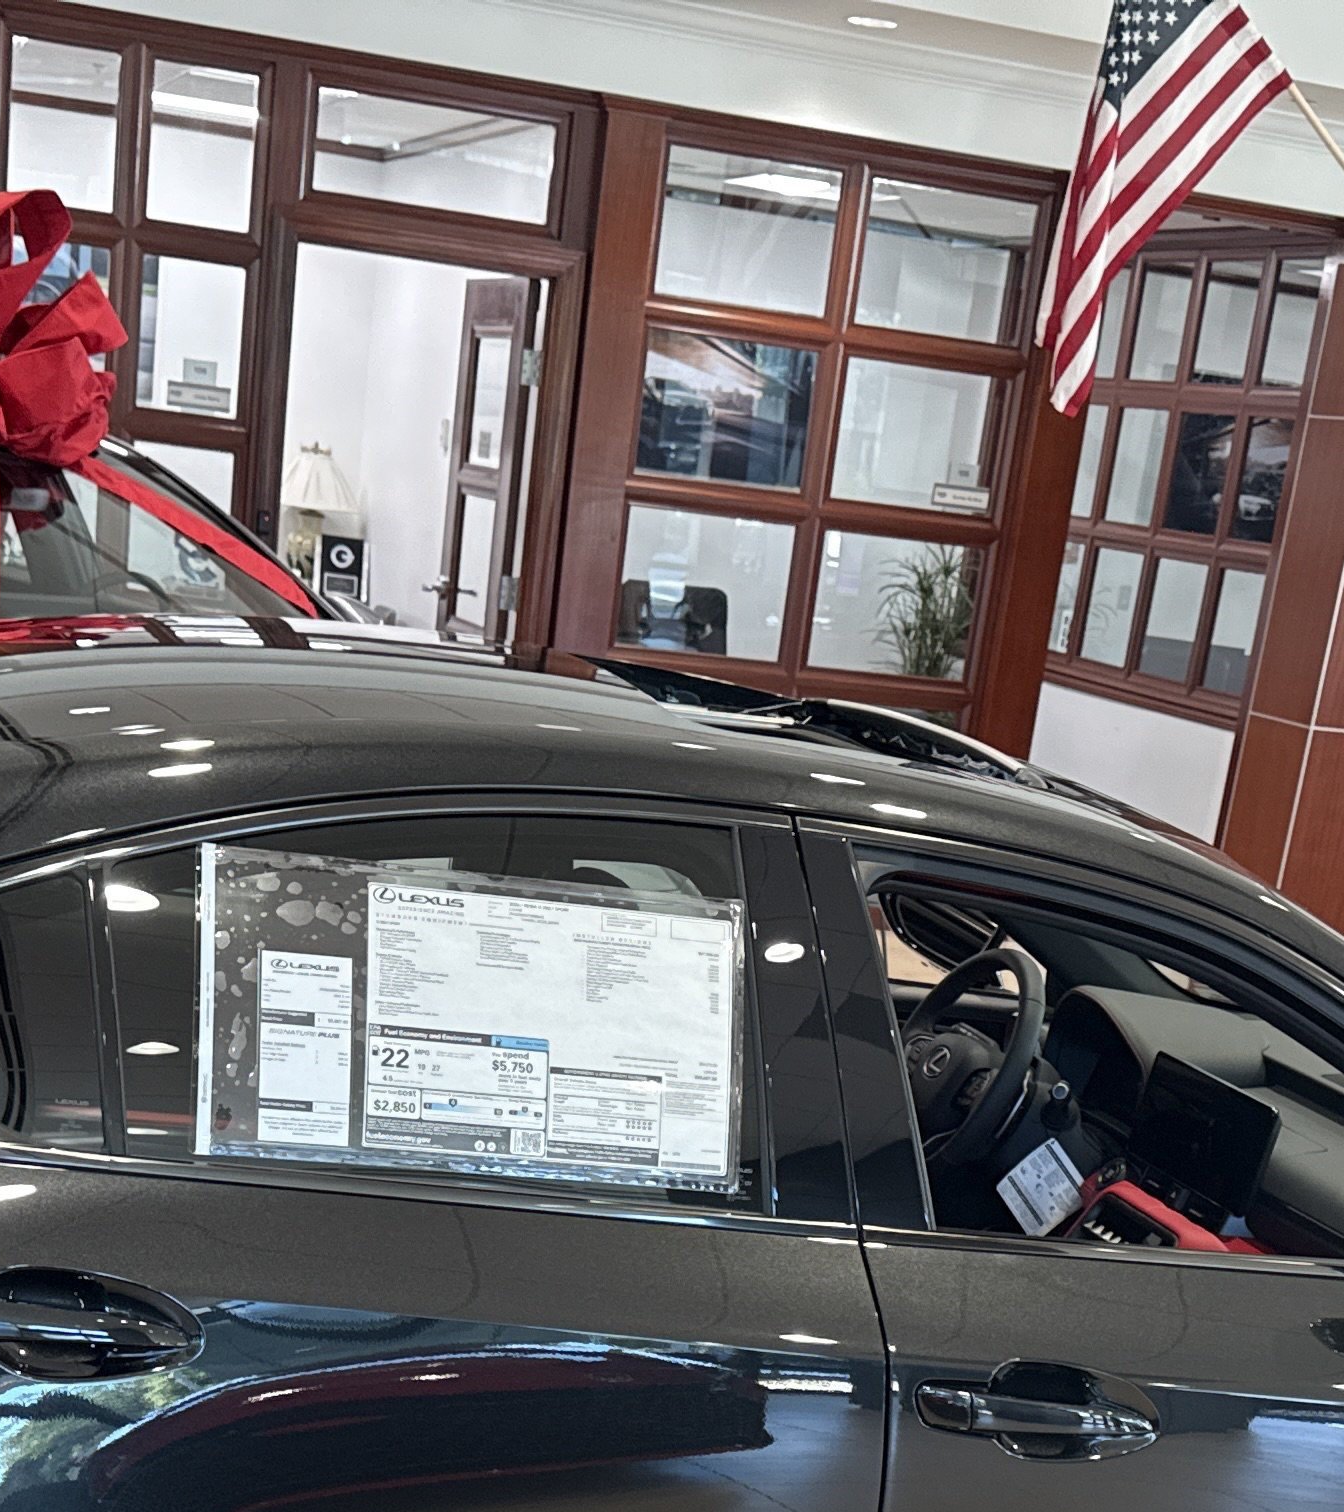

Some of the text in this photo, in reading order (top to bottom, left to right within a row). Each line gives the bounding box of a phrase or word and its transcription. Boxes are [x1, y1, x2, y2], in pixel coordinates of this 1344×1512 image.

[398, 892, 465, 908] LEXUS
[381, 1048, 409, 1069] 22
[492, 1060, 533, 1074] $5,750
[373, 1099, 416, 1114] $2,850
